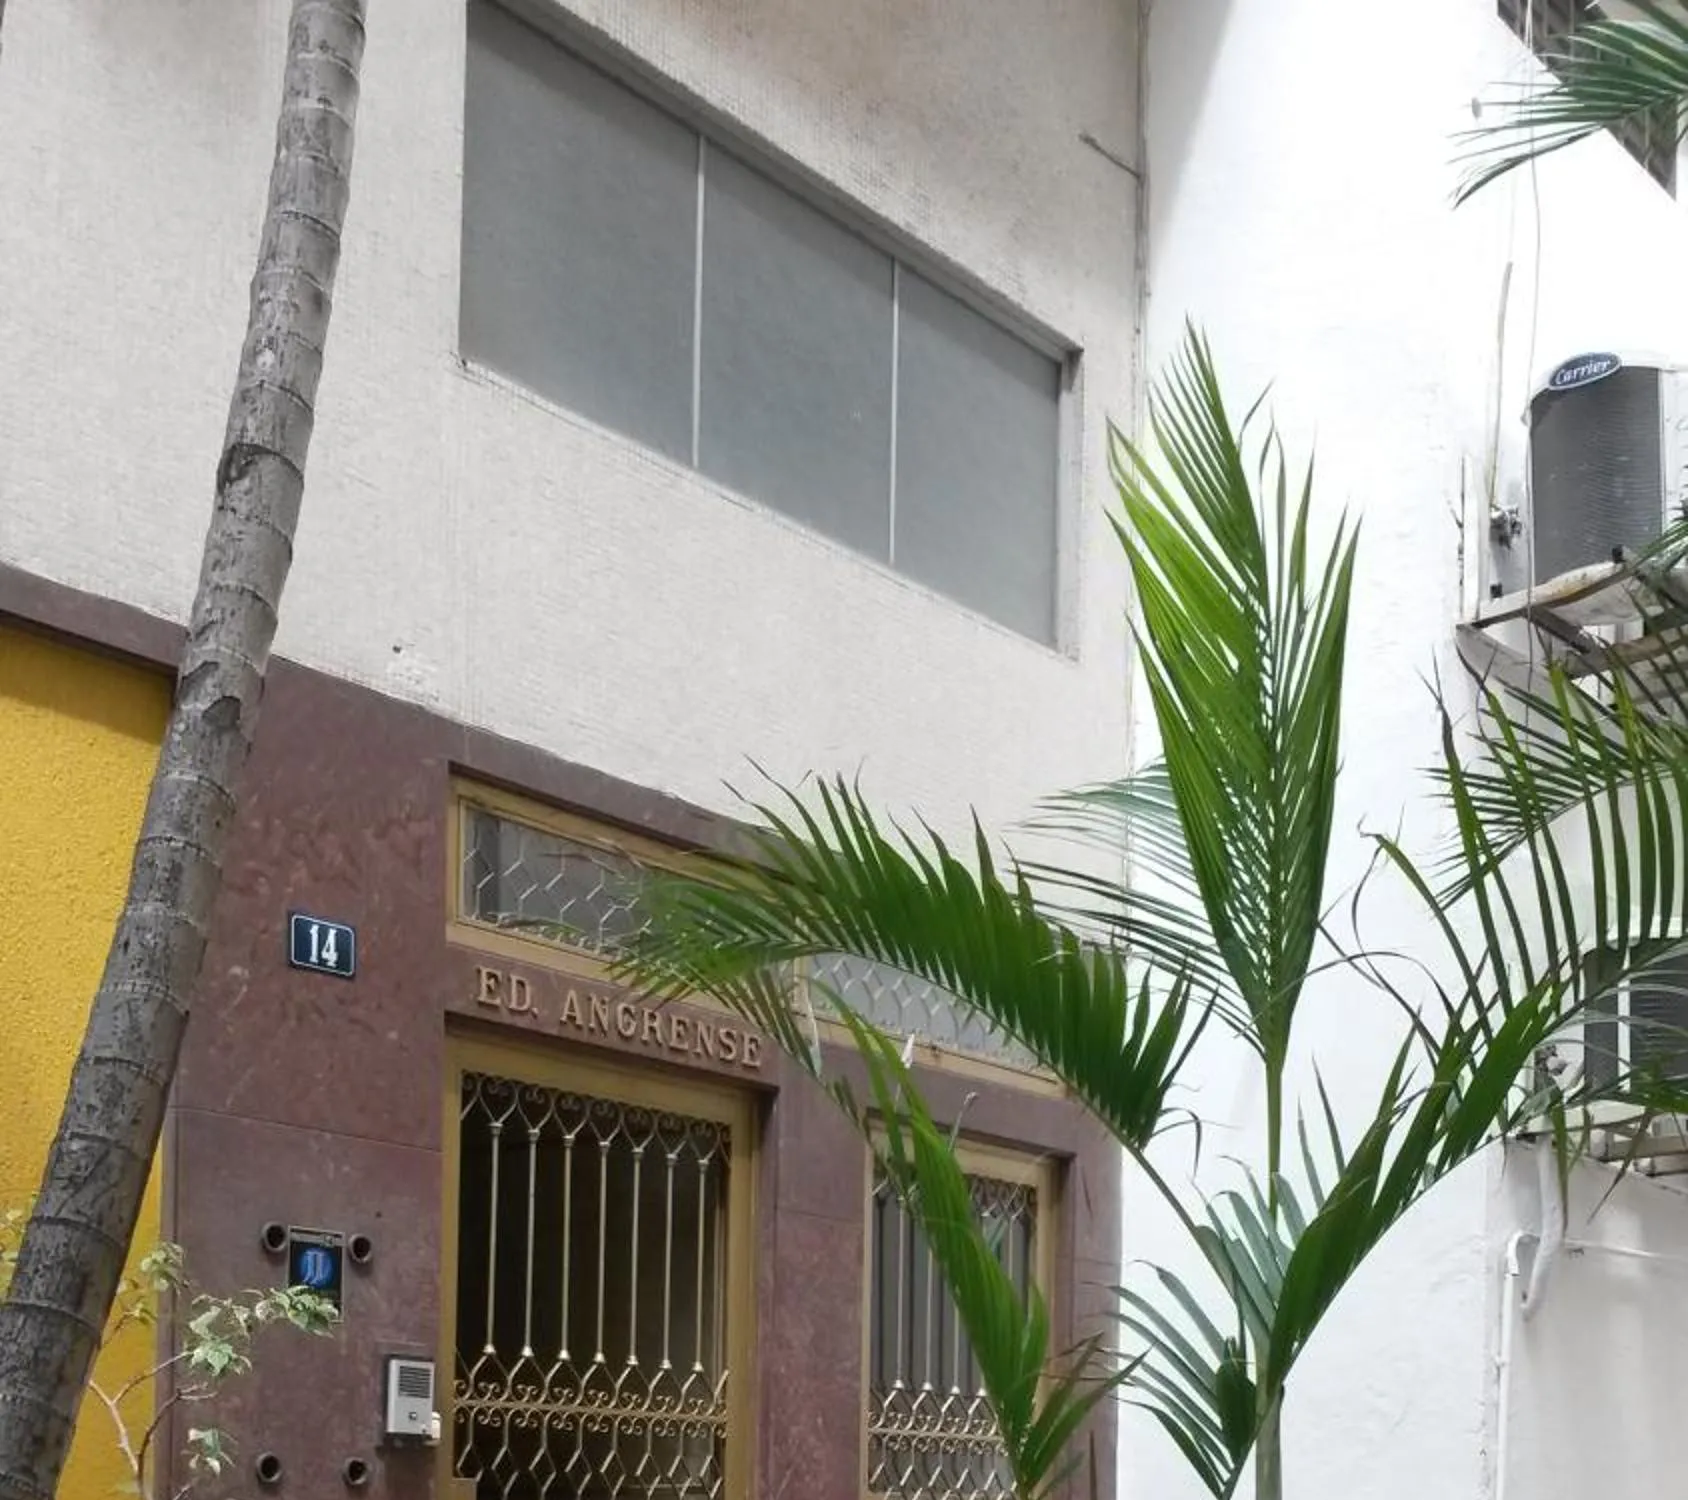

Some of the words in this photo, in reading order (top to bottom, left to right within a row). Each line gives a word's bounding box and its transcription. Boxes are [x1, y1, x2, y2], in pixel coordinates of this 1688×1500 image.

[1555, 359, 1611, 385] Carrier
[309, 924, 338, 968] 14
[475, 965, 539, 1018] ED.
[559, 988, 762, 1068] ANGRENSE
